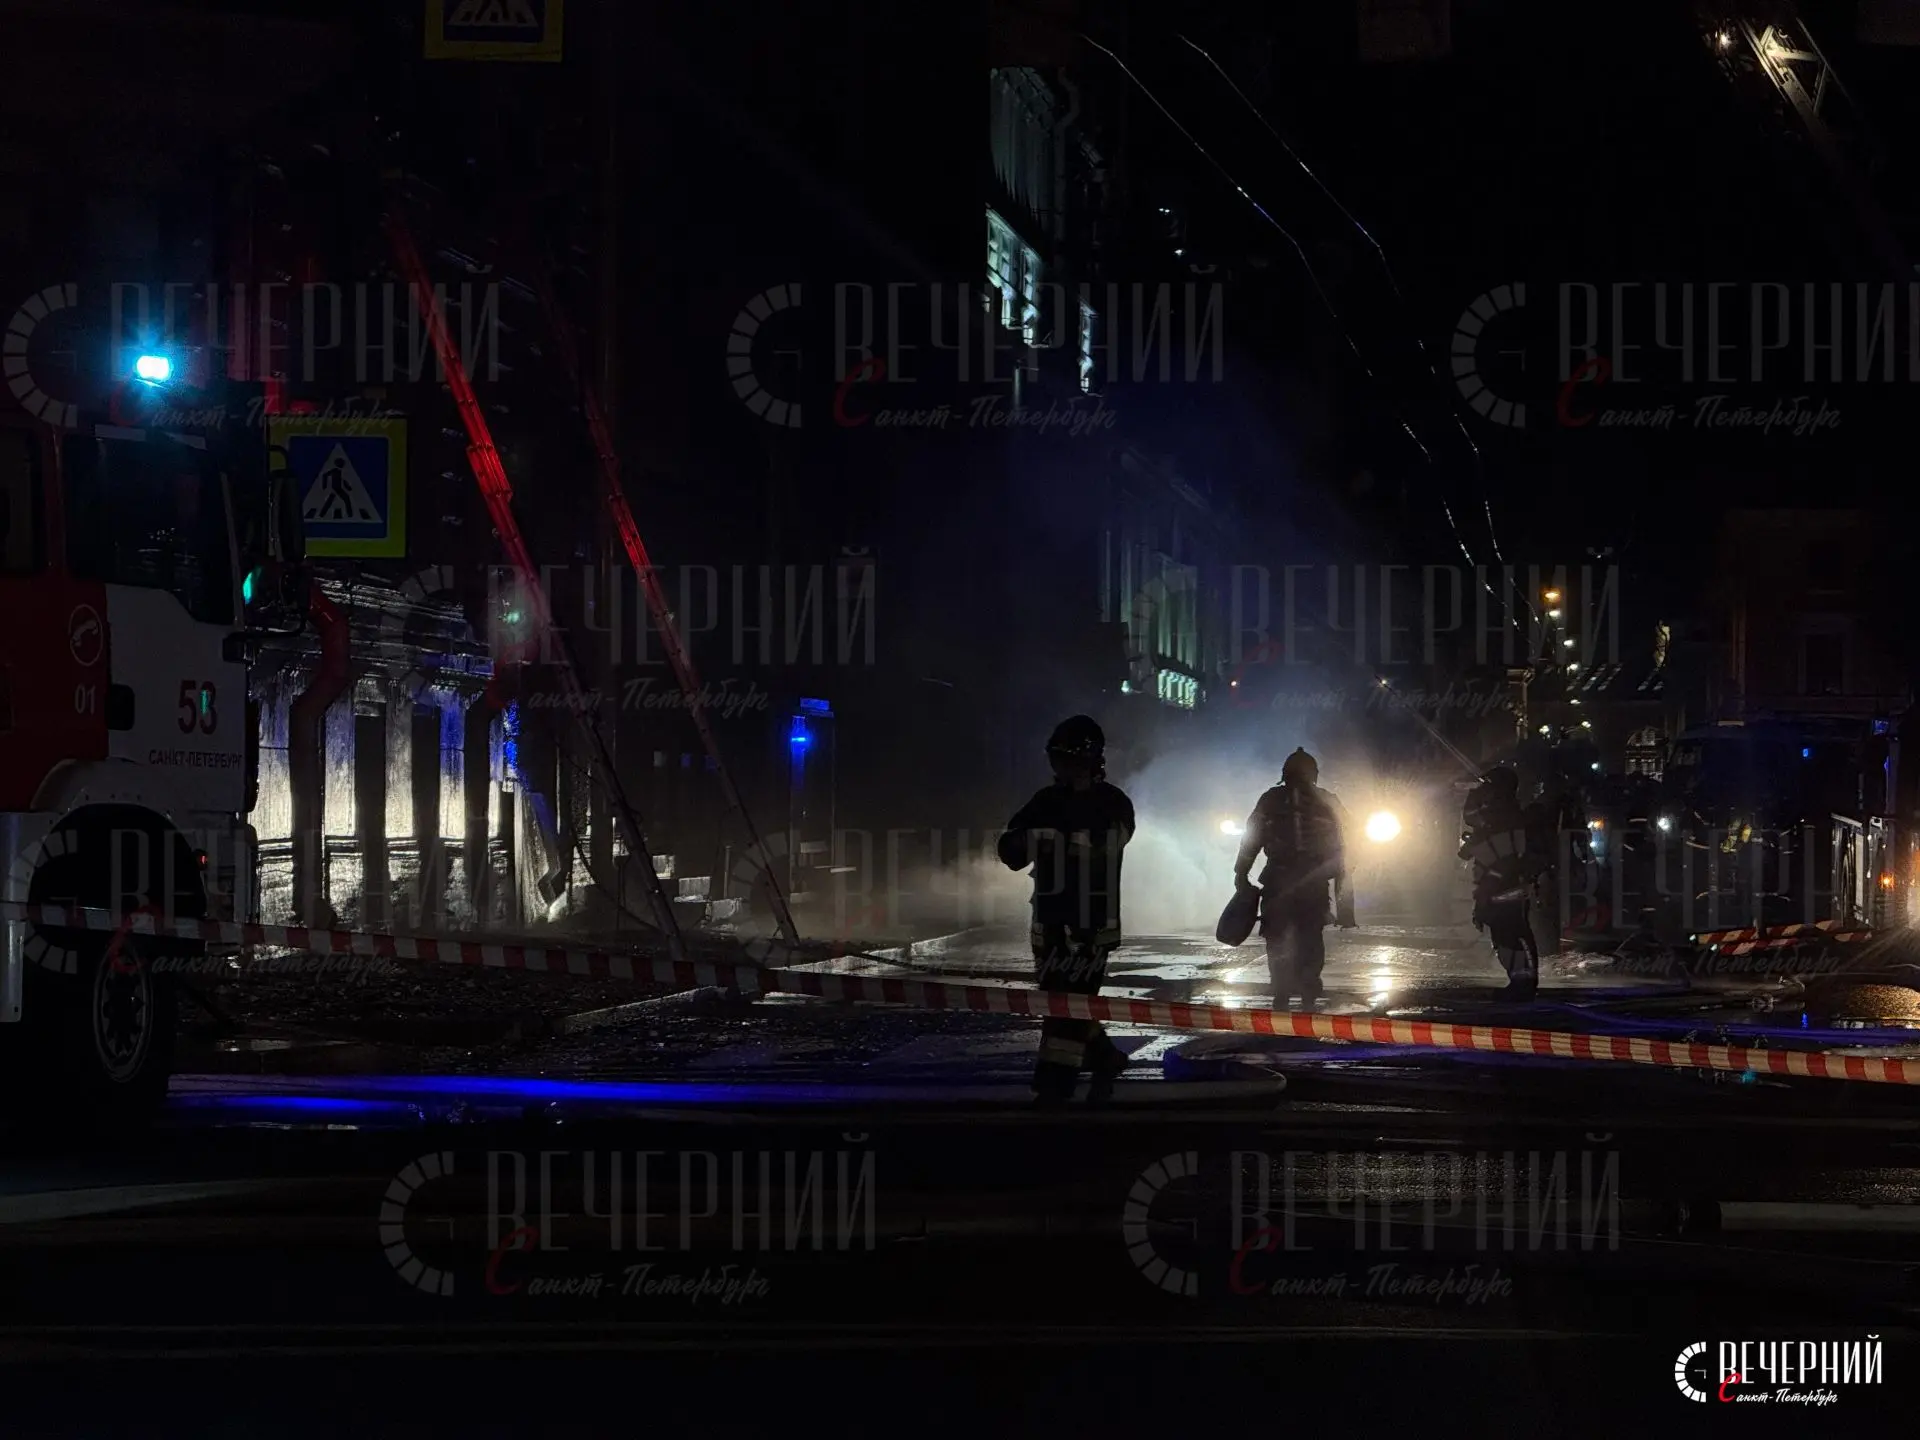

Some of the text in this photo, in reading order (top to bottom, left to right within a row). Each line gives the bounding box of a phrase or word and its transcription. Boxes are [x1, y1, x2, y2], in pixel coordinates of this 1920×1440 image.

[74, 683, 97, 714] 01
[178, 680, 217, 735] 53
[149, 749, 243, 769] САНКТ-ПЕТЕРБУРГ
